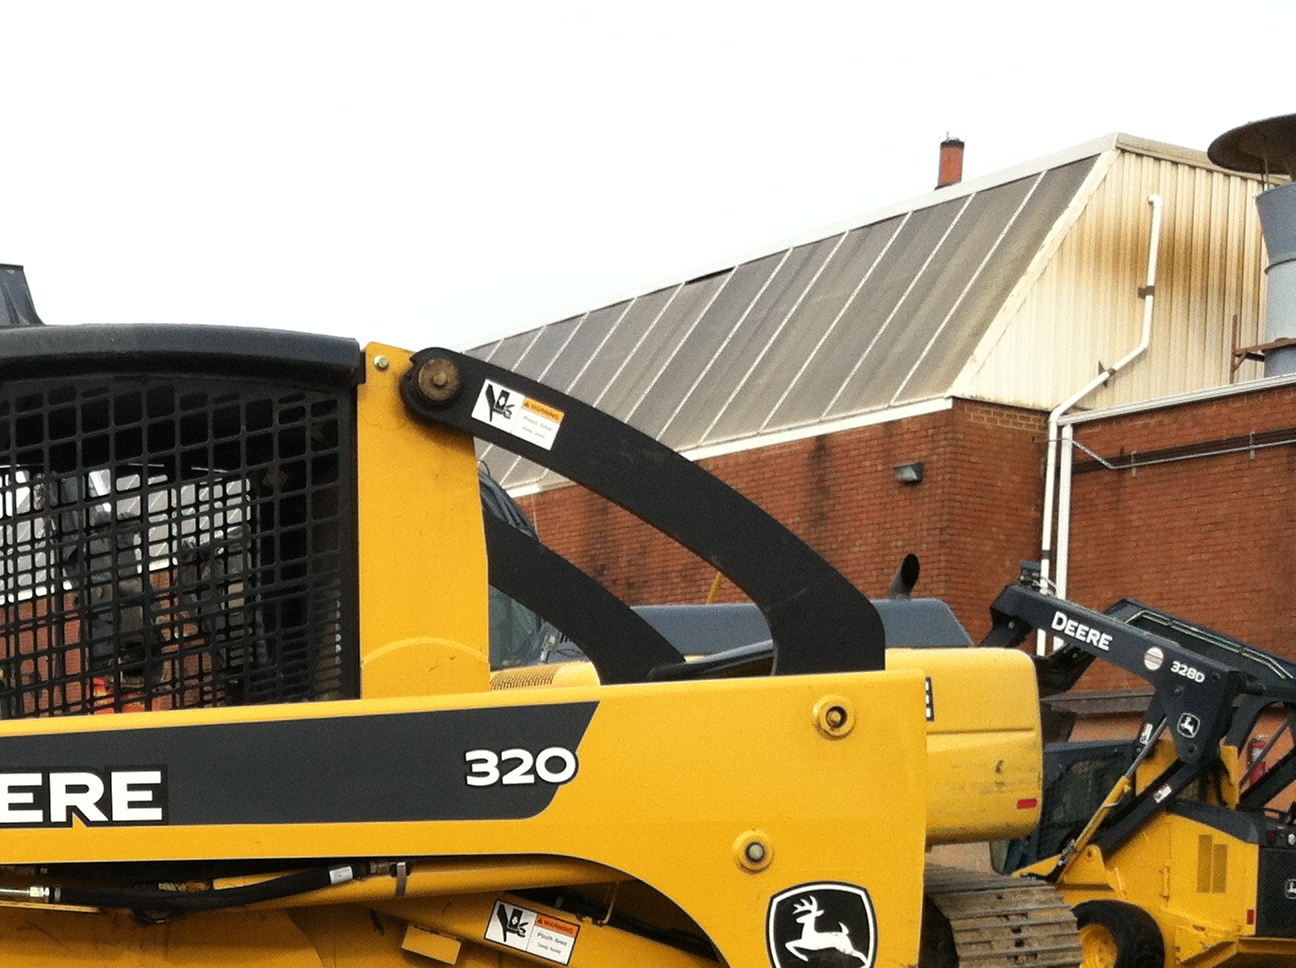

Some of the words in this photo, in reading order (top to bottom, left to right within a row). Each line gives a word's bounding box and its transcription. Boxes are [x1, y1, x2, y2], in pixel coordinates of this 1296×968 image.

[1051, 611, 1113, 652] DEERE
[1170, 660, 1206, 684] 328D
[465, 746, 576, 787] 320
